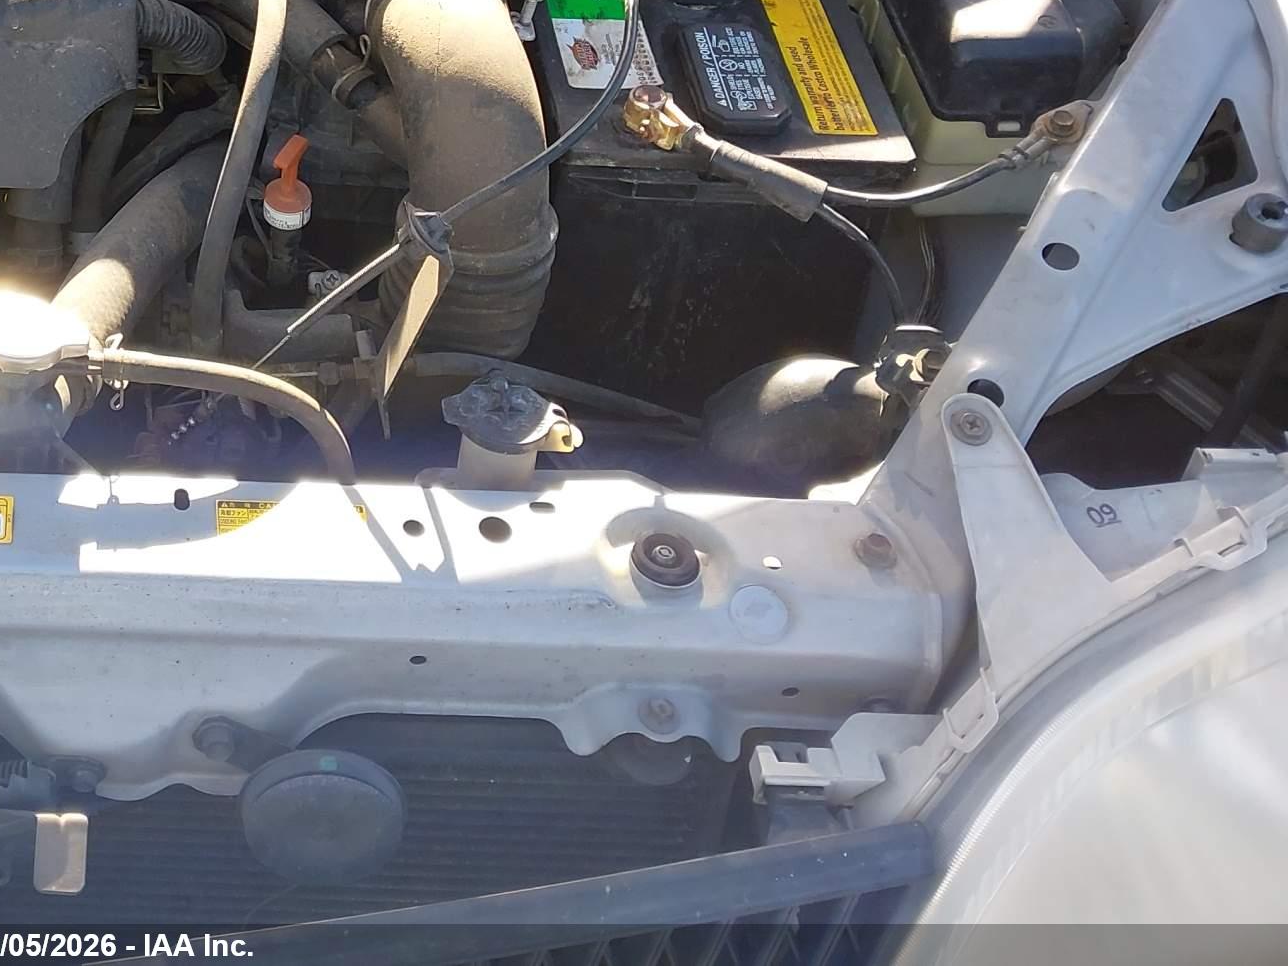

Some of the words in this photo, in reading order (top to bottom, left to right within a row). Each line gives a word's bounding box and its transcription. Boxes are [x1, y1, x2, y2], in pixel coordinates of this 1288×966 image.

[694, 32, 713, 61] POISON
[786, 46, 802, 63] used
[798, 36, 820, 71] Wholesale
[706, 67, 724, 99] DANGER
[792, 63, 808, 76] and
[800, 75, 819, 107] warranty
[813, 106, 831, 131] Return
